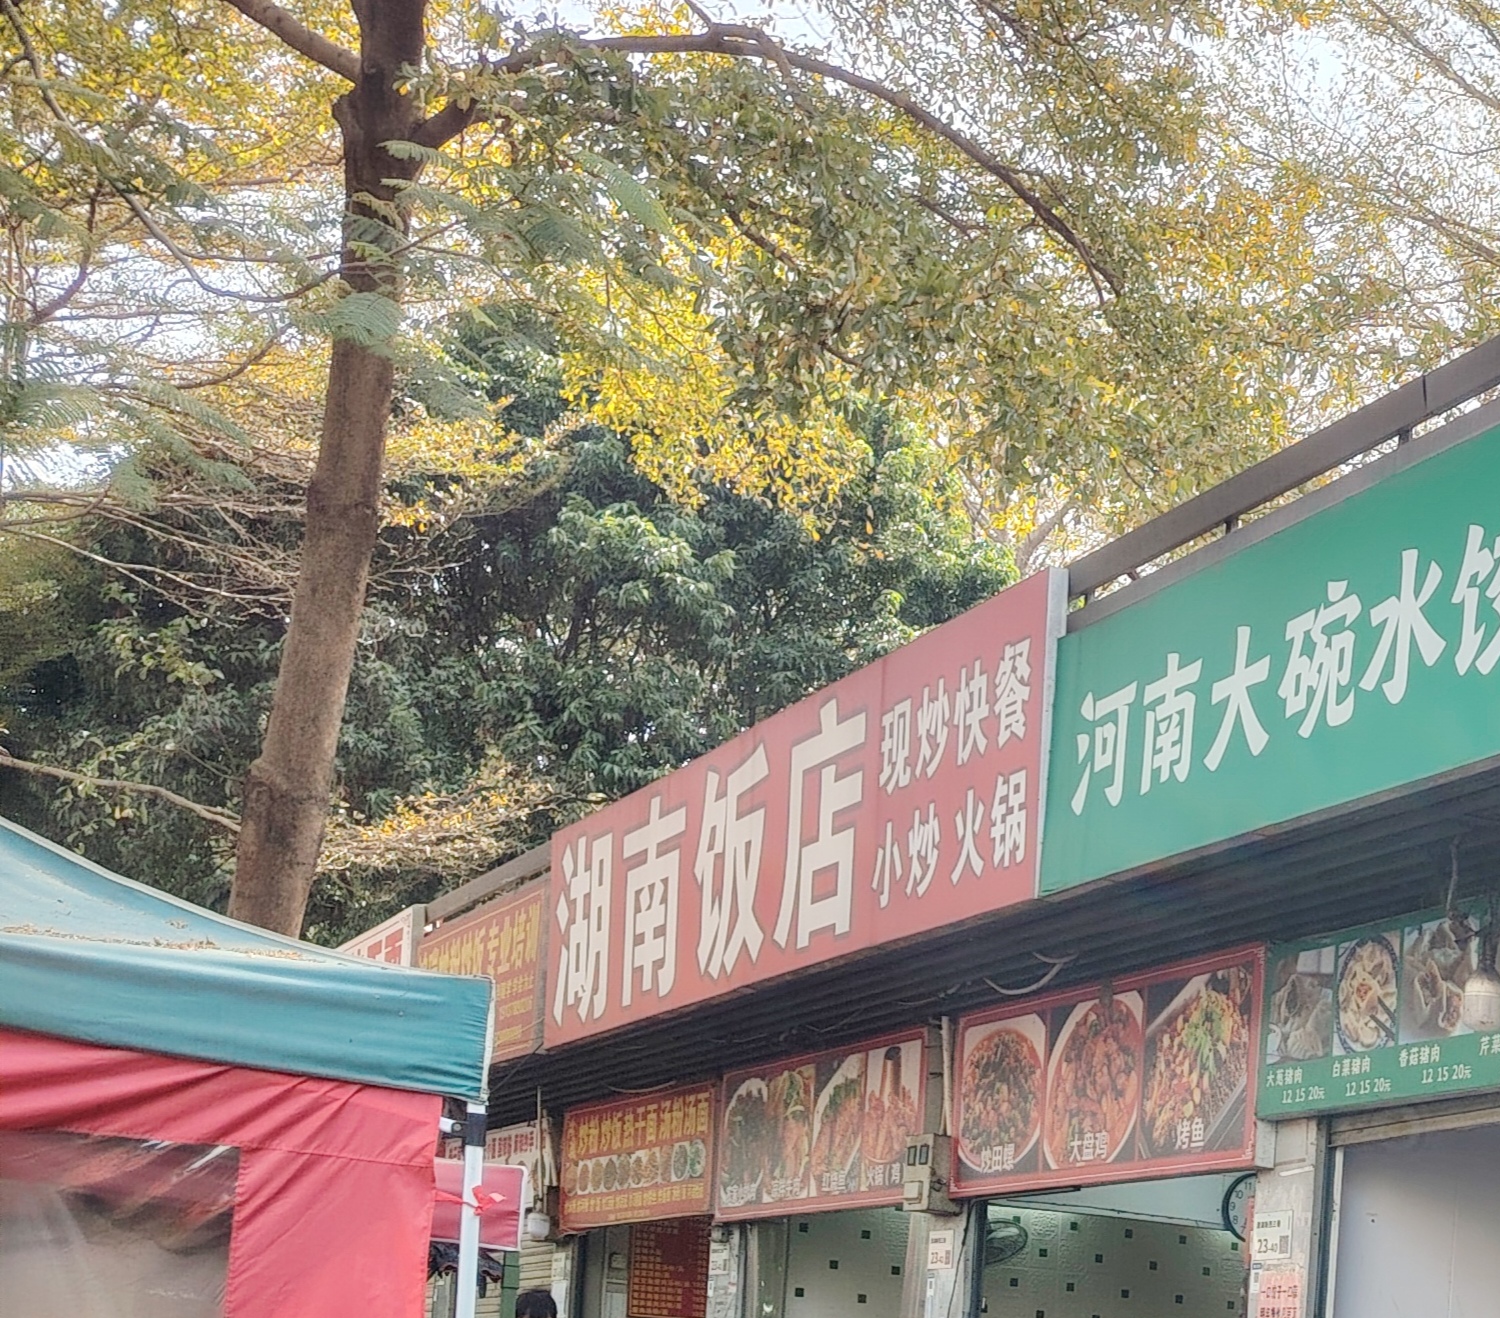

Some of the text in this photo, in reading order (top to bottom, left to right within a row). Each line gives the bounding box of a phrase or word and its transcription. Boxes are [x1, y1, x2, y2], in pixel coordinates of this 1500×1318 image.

[878, 637, 1034, 797] 现炒快餐
[552, 697, 868, 1028] 湖南饭店
[1332, 1057, 1371, 1078] 白菜猪肉
[1398, 1044, 1441, 1068] 香菇猪肉
[1266, 1066, 1303, 1087] 大葱猪肉
[1422, 1064, 1472, 1084] 12 15 20元
[1282, 1085, 1325, 1104] 12 15 20元
[1345, 1078, 1391, 1097] 12 15 20元
[1175, 1117, 1205, 1150] 烤鱼
[981, 1143, 1015, 1173] 炒田螺
[1069, 1131, 1109, 1162] 大盘鸡
